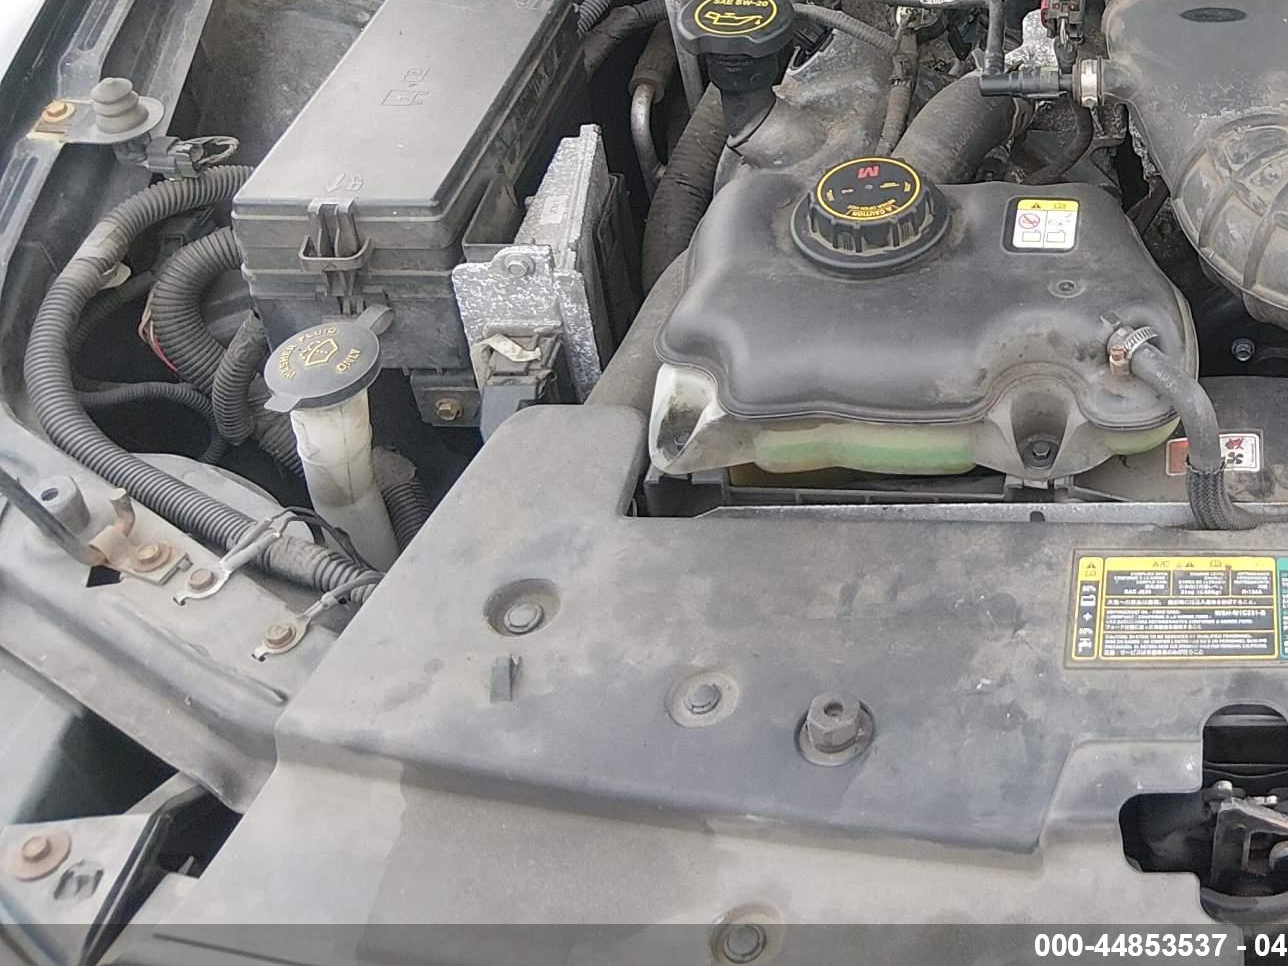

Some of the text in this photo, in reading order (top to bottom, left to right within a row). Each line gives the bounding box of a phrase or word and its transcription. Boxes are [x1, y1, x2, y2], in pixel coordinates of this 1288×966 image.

[852, 209, 885, 217] CAUTION
[278, 326, 337, 379] WASHER FLUID
[336, 347, 361, 372] ONLY
[1152, 560, 1170, 568] A/C
